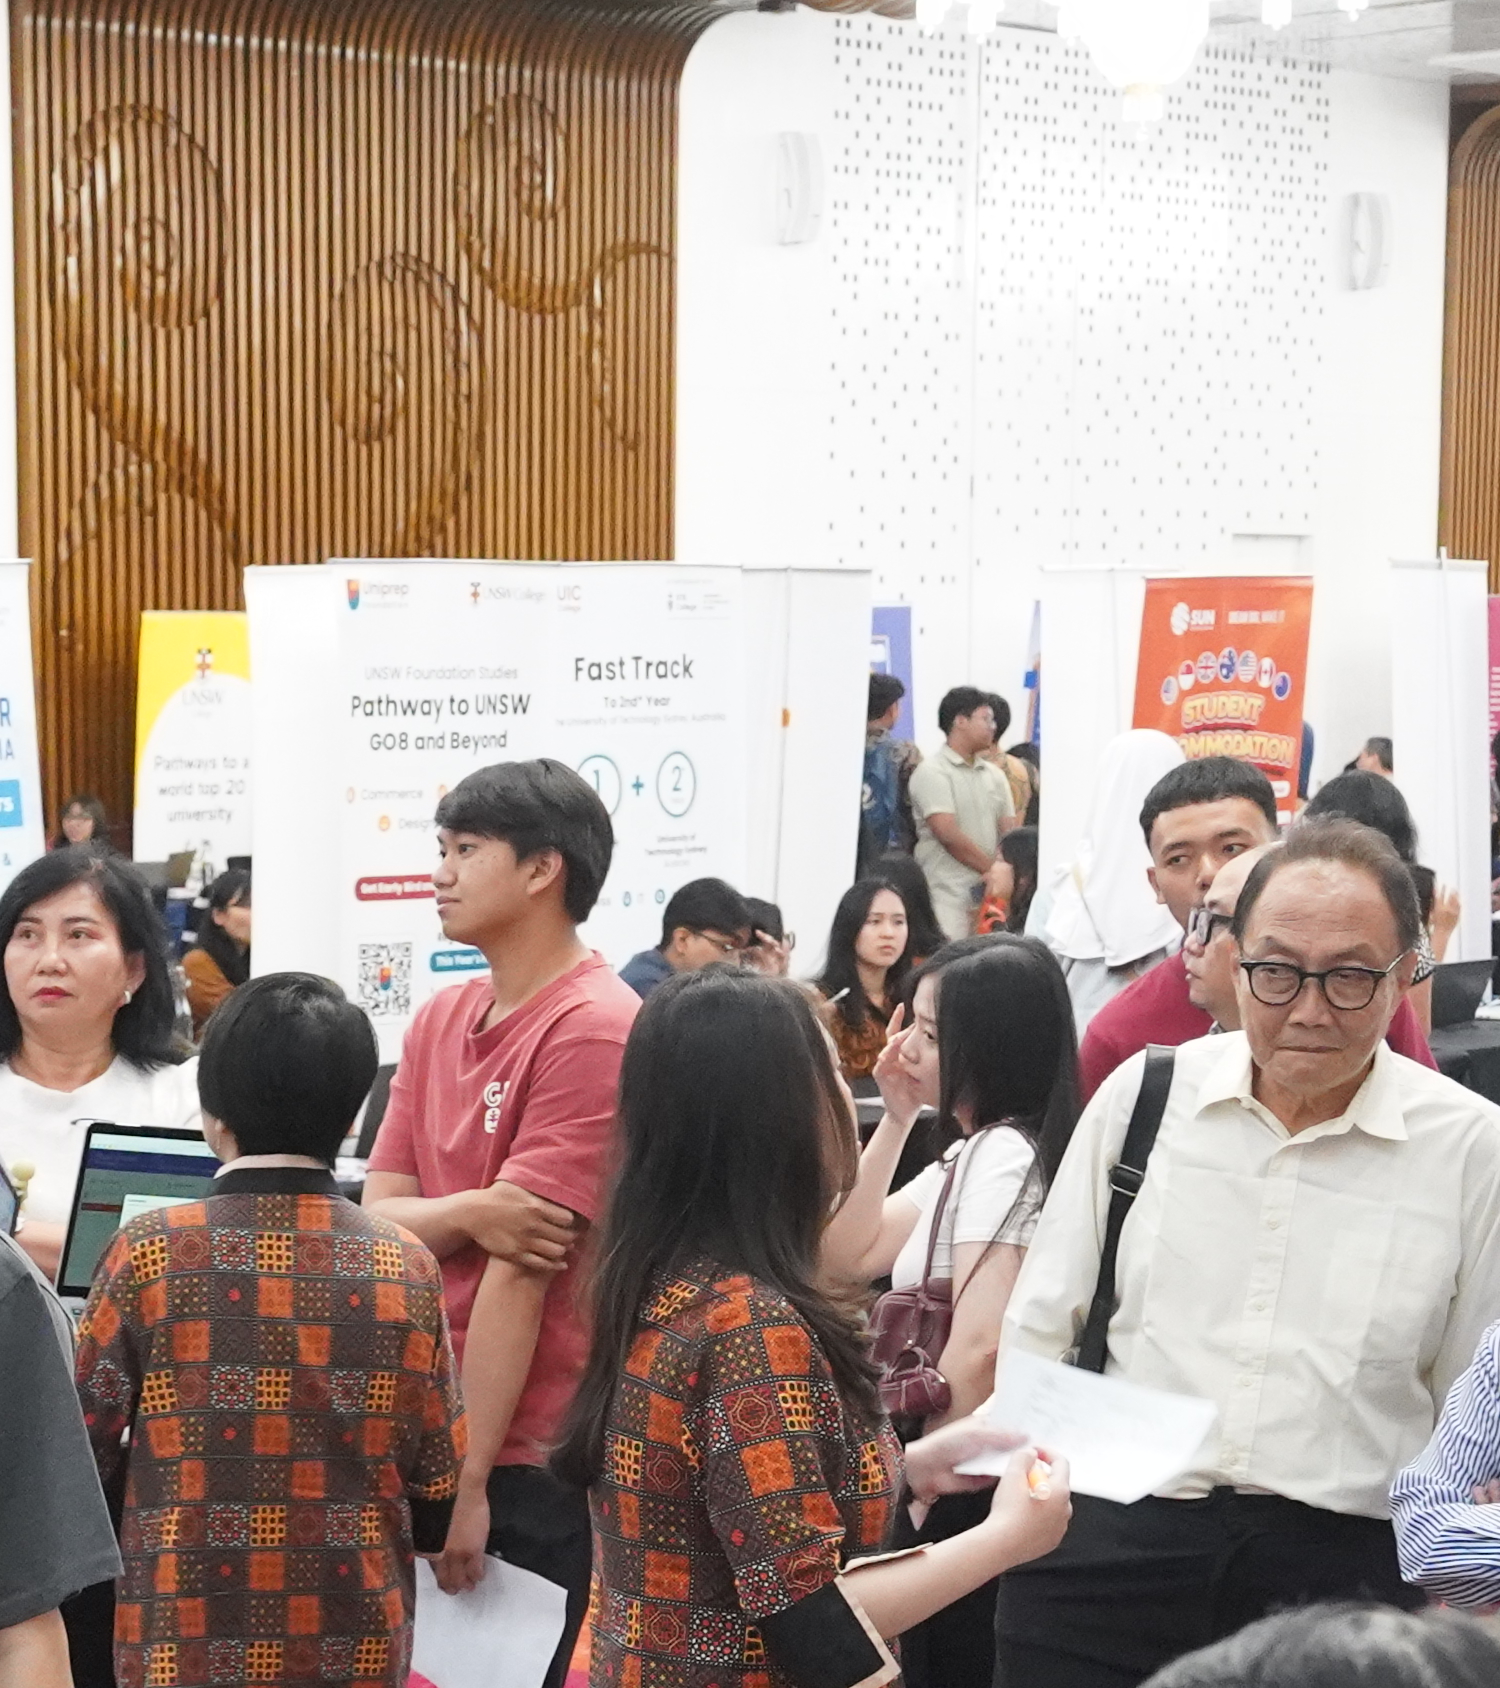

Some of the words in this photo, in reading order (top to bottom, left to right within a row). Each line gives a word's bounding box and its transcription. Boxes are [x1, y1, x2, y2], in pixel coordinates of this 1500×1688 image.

[363, 581, 410, 597] Uniprep
[556, 585, 582, 601] UIC
[1191, 610, 1216, 625] SUN
[364, 667, 401, 680] UNSW
[406, 666, 475, 680] Foundation
[478, 666, 518, 680] Studies
[574, 656, 625, 682] Fast
[631, 653, 694, 680] Track
[351, 694, 443, 724] Pathway
[449, 695, 469, 716] to
[474, 693, 531, 715] UNSW
[645, 696, 671, 708] Year
[1184, 695, 1263, 724] STUDENT
[369, 732, 409, 751] GO8
[415, 732, 445, 750] and
[450, 730, 508, 756] Beyond
[1179, 733, 1295, 767] OMMODATION
[154, 755, 217, 773] Pathways
[222, 755, 238, 769] to
[672, 766, 681, 791] 2
[157, 781, 194, 797] world
[197, 782, 221, 799] top
[225, 778, 246, 796] 20
[361, 788, 424, 801] Commerce
[167, 807, 233, 825] university
[3, 852, 12, 867] &
